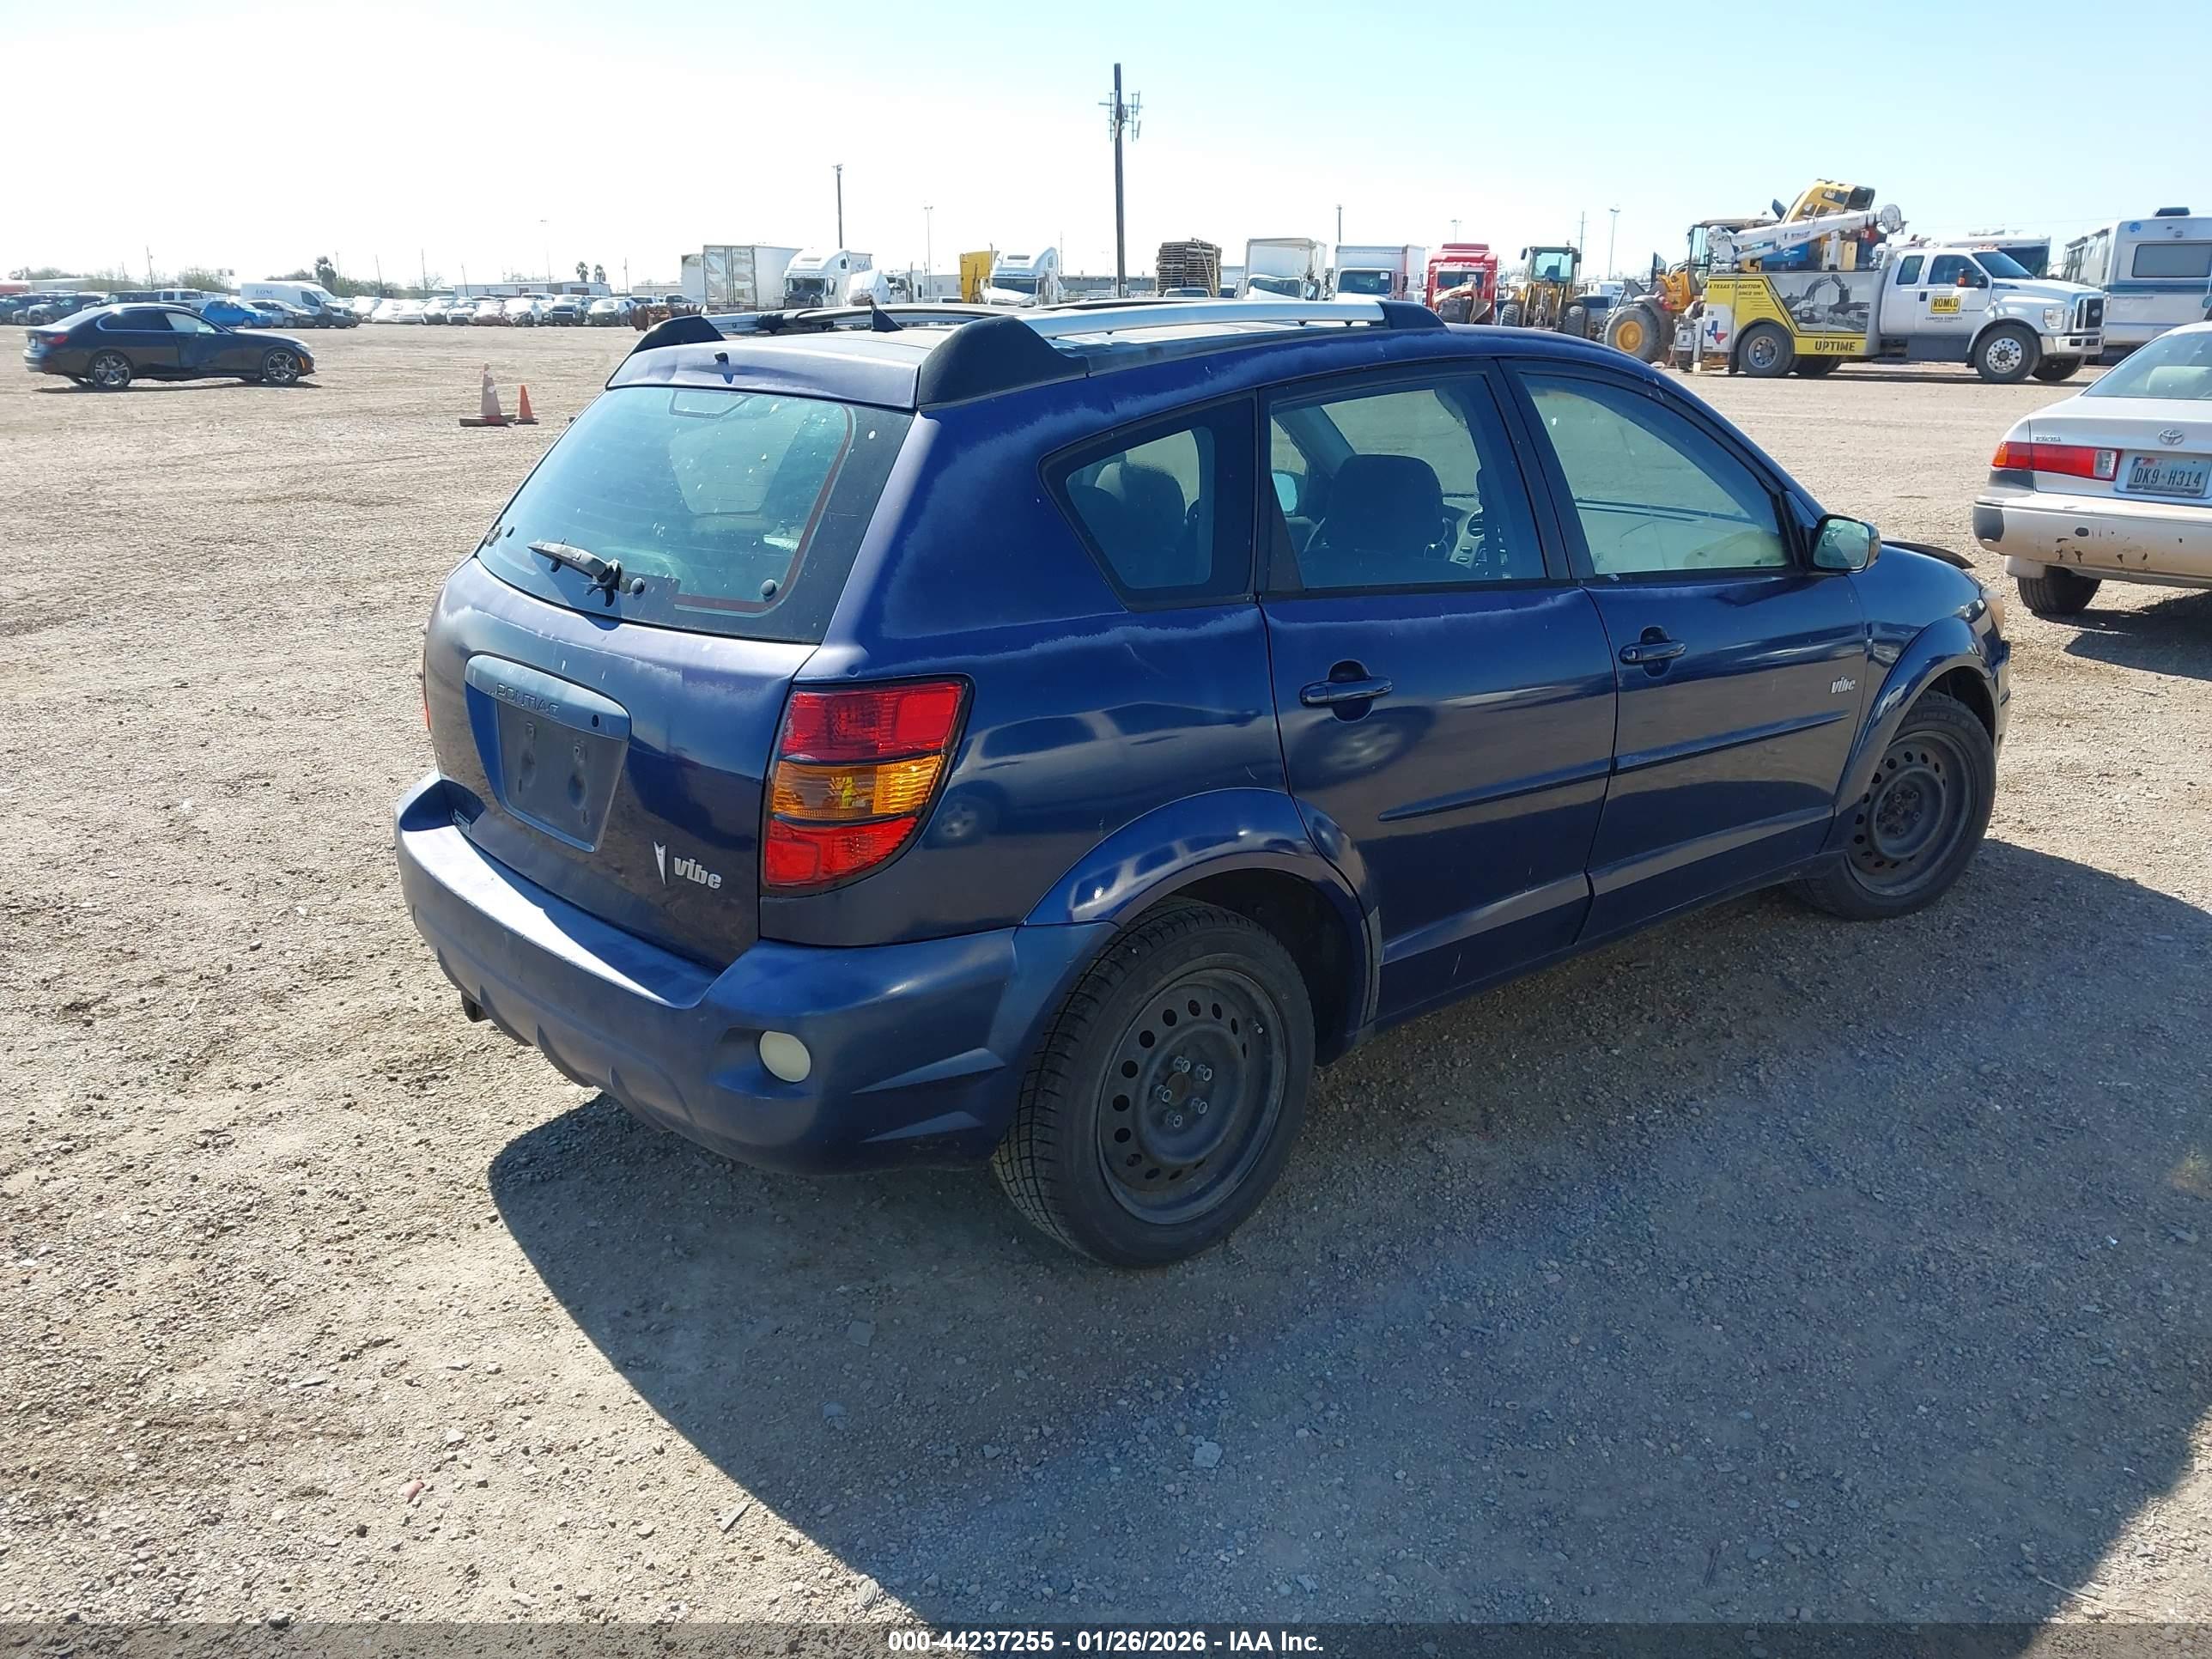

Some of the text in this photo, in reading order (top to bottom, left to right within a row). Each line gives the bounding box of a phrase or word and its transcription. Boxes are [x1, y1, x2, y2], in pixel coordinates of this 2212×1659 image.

[1933, 297, 1959, 307] ROMCO
[1814, 340, 1856, 352] UPTIME
[2134, 467, 2203, 488] DK9 H314
[1831, 676, 1856, 694] vibe
[495, 683, 559, 720] PONTIAC
[673, 857, 722, 890] vibe
